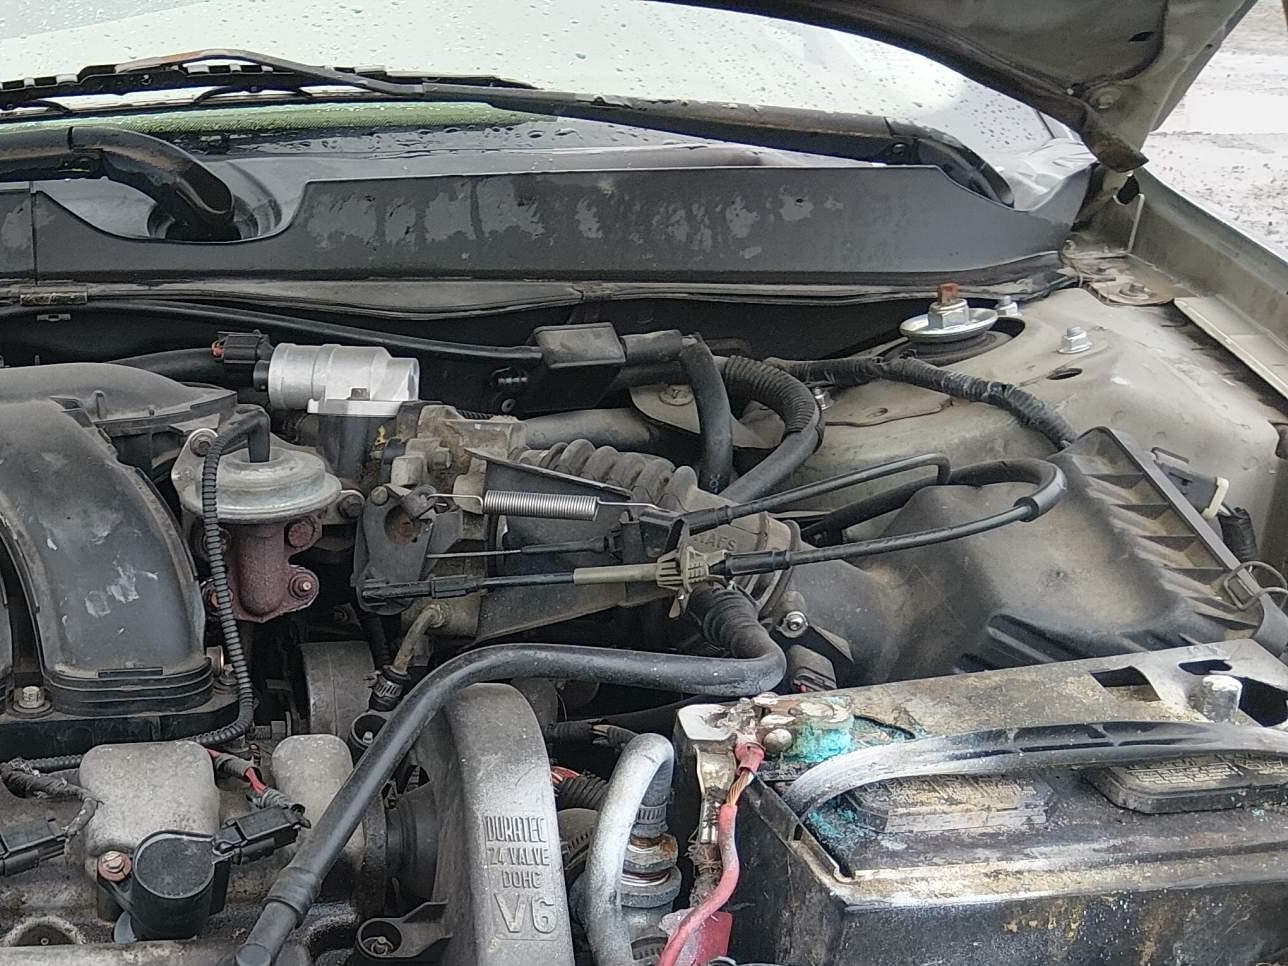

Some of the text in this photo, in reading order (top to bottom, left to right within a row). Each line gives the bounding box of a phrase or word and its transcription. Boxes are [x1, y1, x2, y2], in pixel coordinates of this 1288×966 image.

[485, 815, 548, 843] DURATEC
[488, 848, 550, 866] 24 VALVE
[502, 870, 542, 889] DOHC
[494, 893, 557, 934] V6
